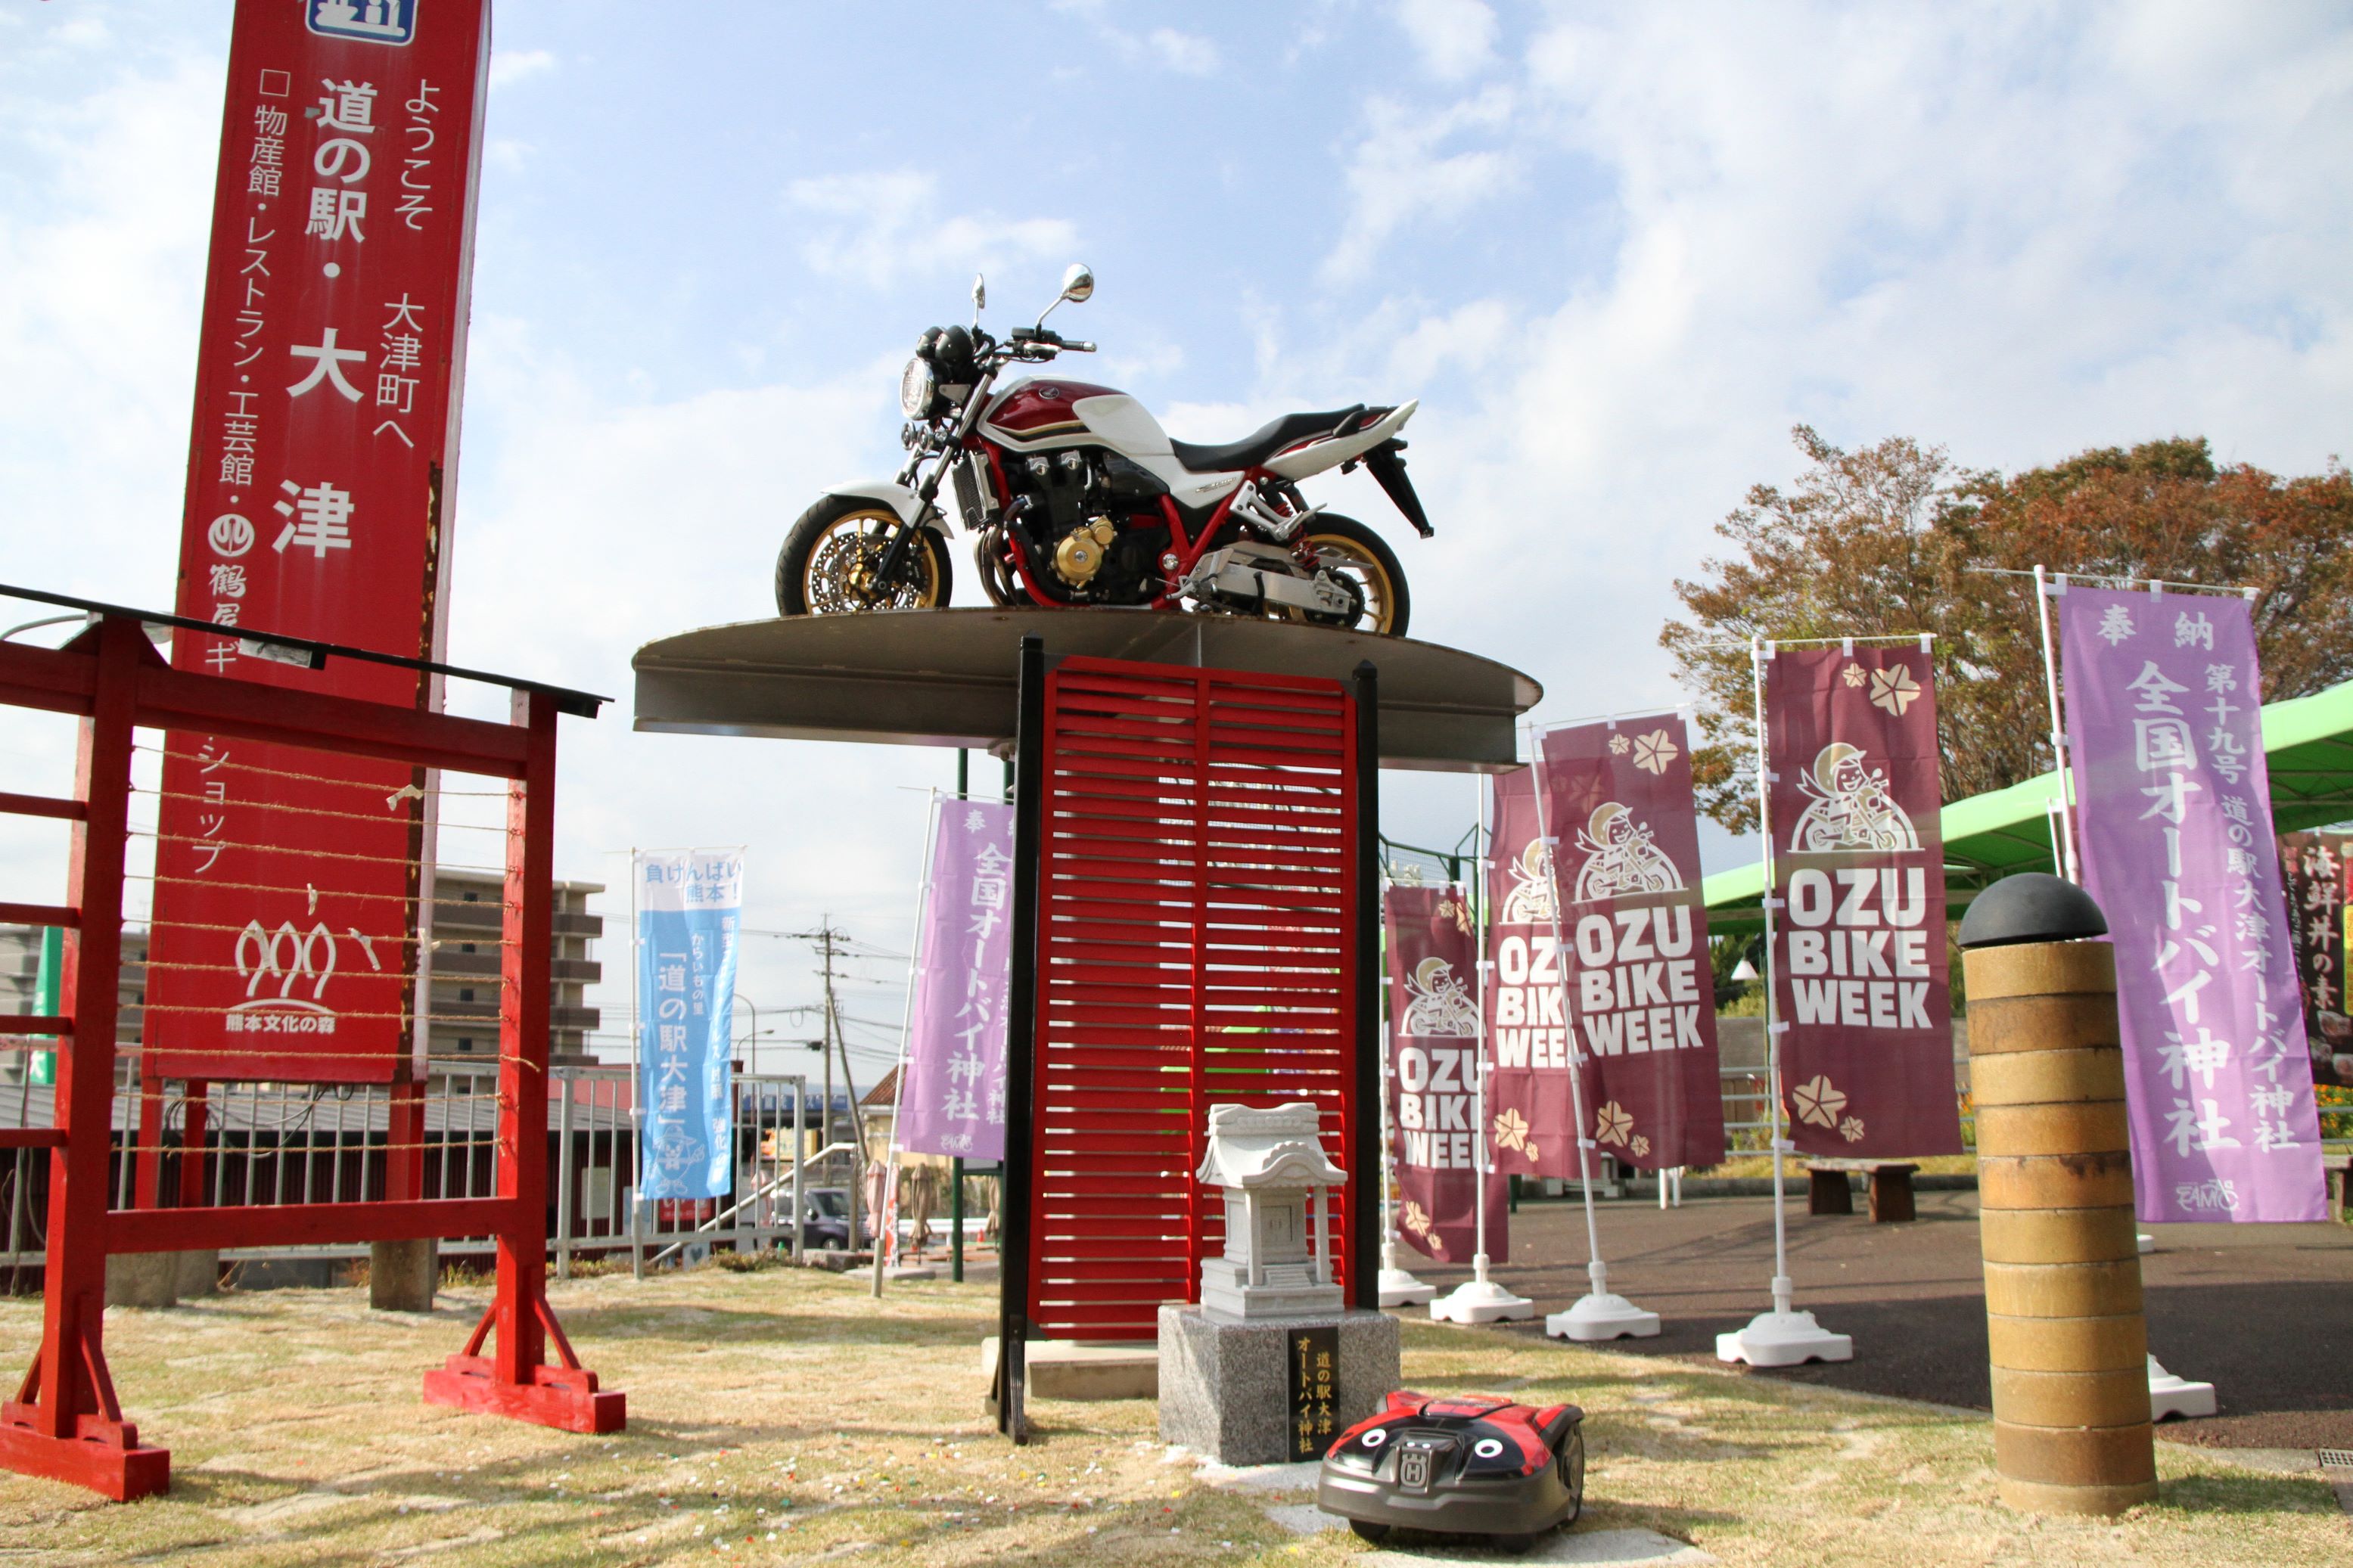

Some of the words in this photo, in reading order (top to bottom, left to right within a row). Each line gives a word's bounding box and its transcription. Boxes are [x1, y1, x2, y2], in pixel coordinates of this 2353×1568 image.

[395, 79, 440, 231] ようこそ
[373, 293, 425, 449] 大津町へ
[2097, 604, 2214, 650] 奉納
[2203, 663, 2247, 784] 第十九号
[645, 861, 742, 884] 負けんばい
[686, 882, 738, 903] 熊本！
[1789, 868, 1926, 927] OZU
[1576, 905, 1692, 967] OZU
[2125, 660, 2242, 1158] 全国オートバイ神社
[940, 843, 1012, 1120] 全国オートバイ神社
[1498, 936, 1568, 986] OZ
[1789, 930, 1930, 978] BIKE
[2222, 794, 2302, 1153] 道の駅大津オートバイ神社
[1496, 986, 1571, 1026] BIK
[1580, 958, 1700, 1013] BIKE
[1791, 978, 1934, 1029] WEEK
[225, 1012, 336, 1035] 熊本文化の森
[657, 952, 688, 1125] 「道の駅大津」
[1582, 1004, 1705, 1057] WEEK
[1298, 1337, 1314, 1455] オートバイ神社
[1316, 1351, 1332, 1436] 道の駅大津
